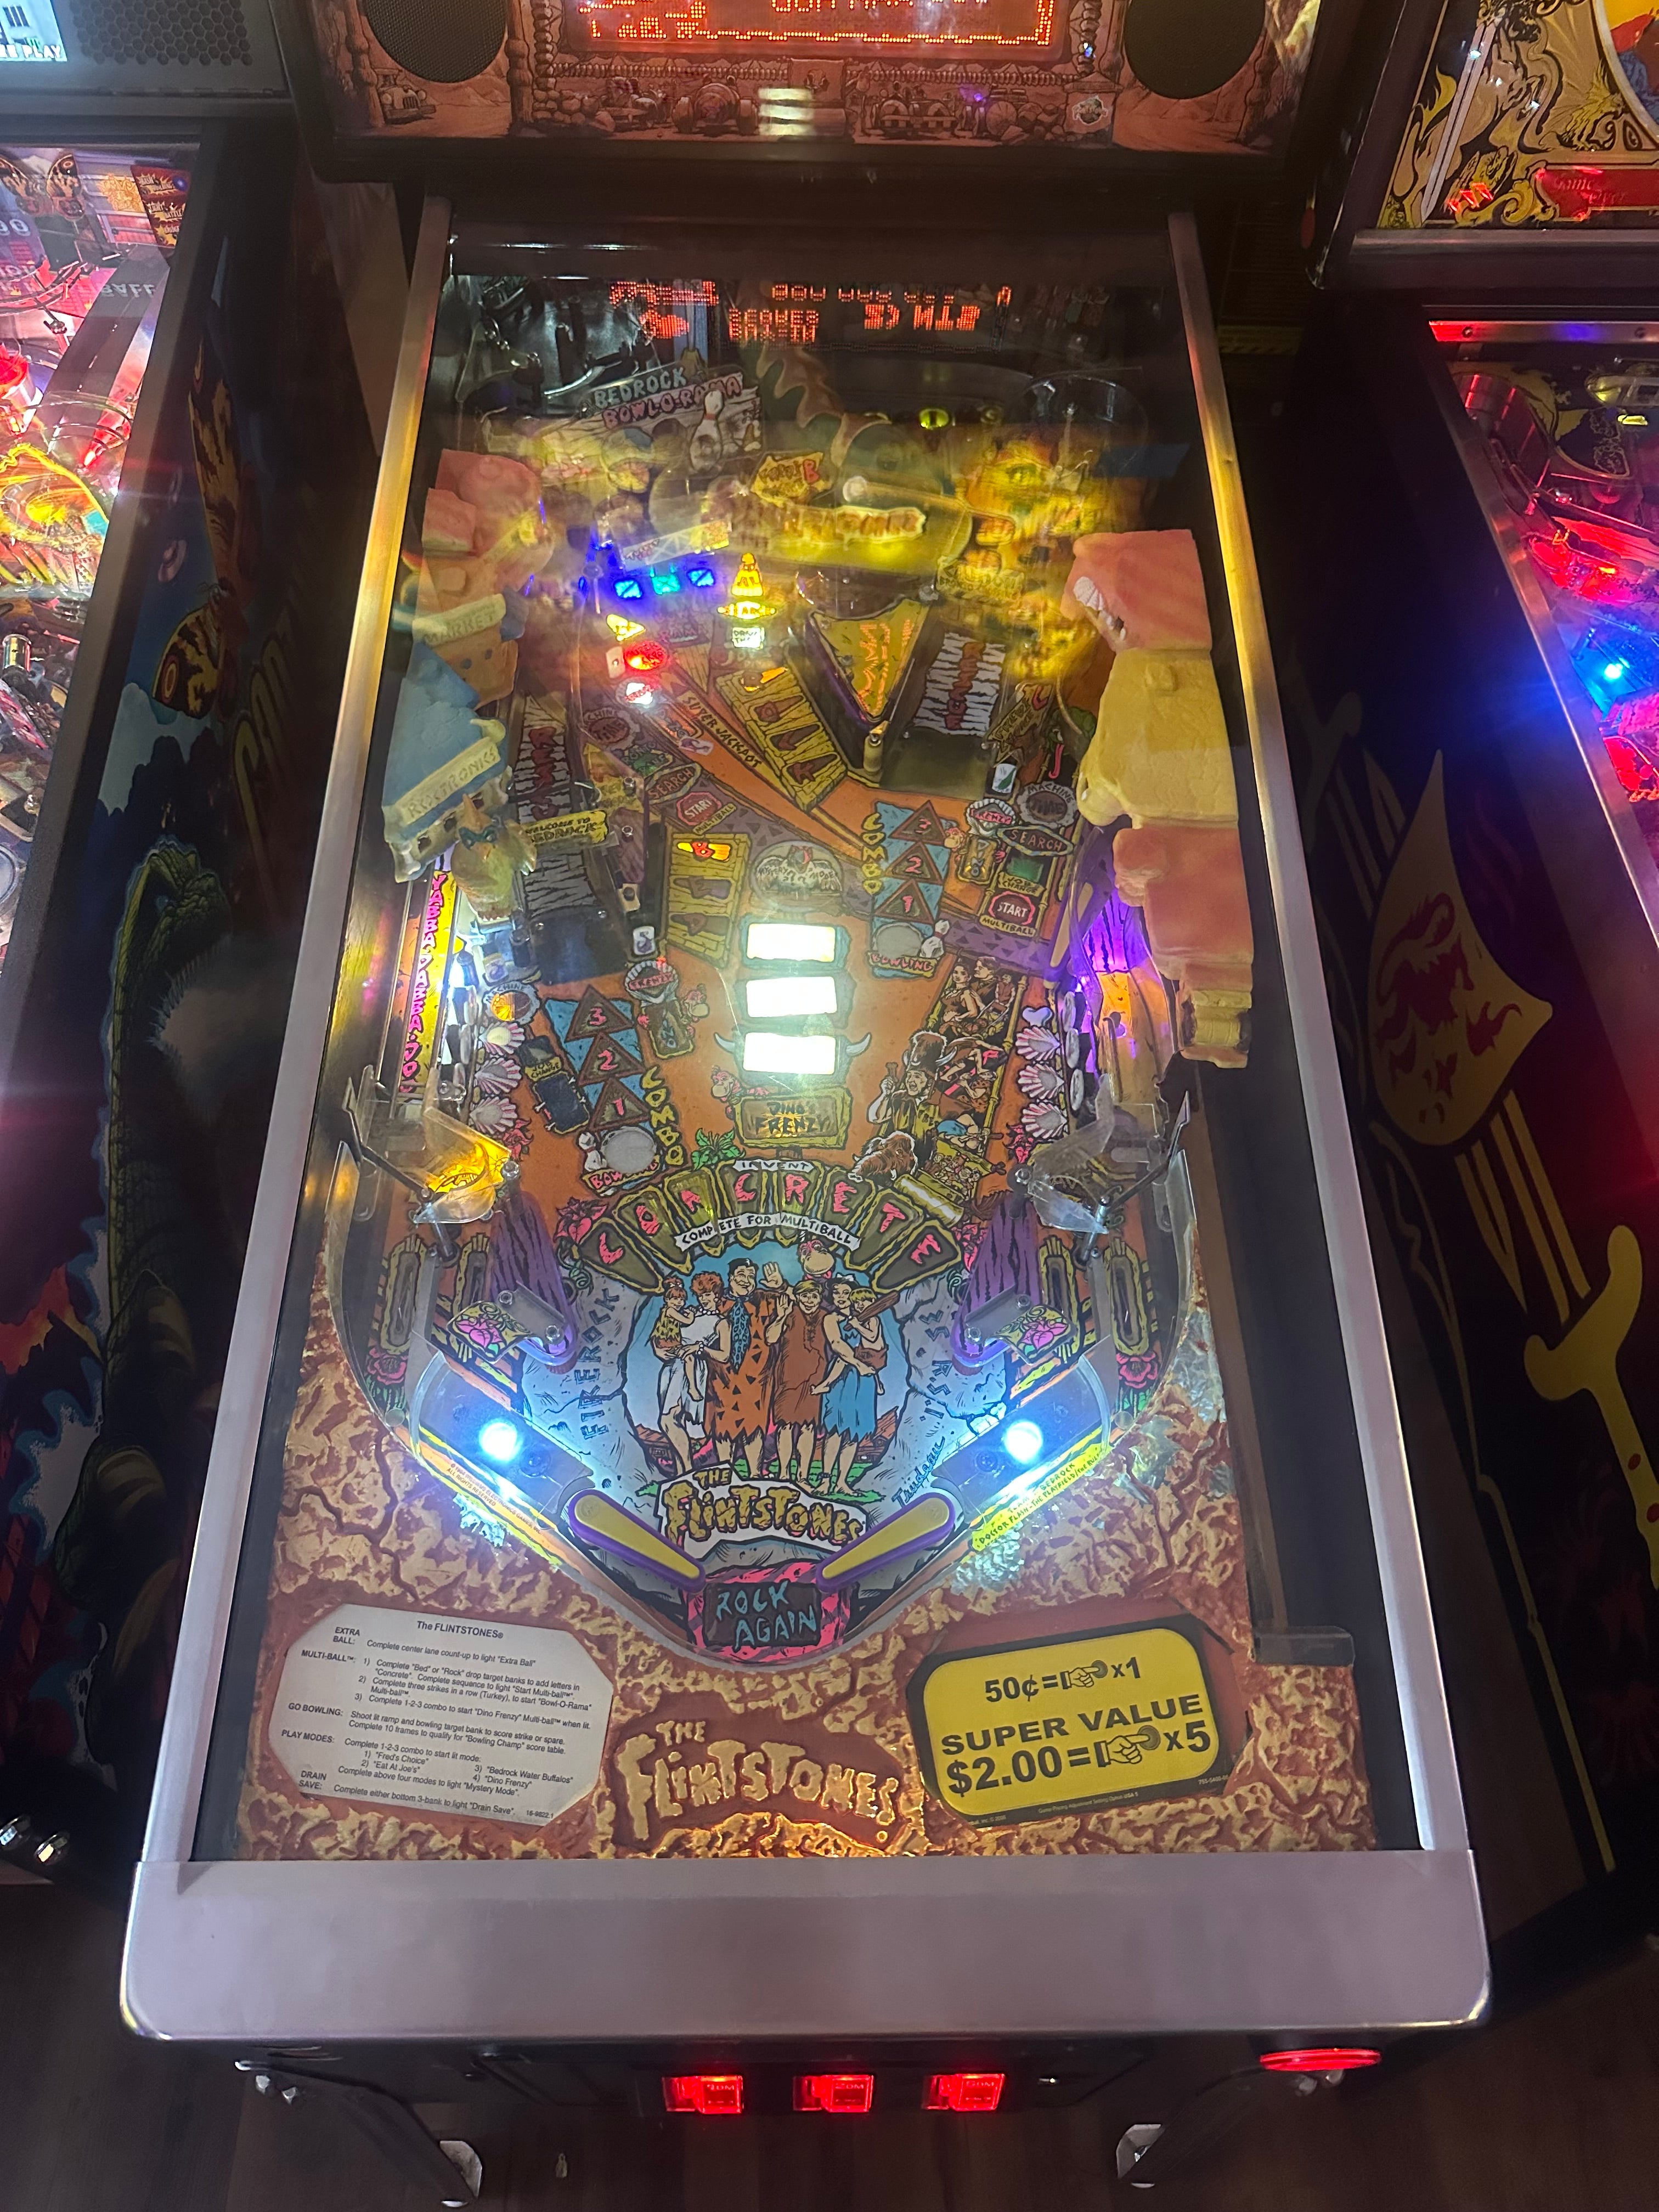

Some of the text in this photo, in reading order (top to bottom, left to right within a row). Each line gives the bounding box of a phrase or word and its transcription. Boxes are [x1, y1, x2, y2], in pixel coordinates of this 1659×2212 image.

[22, 44, 61, 59] PLAY
[594, 366, 686, 409] BEDROCK
[684, 695, 718, 729] SUPER
[715, 725, 762, 768] JACKPOT
[648, 768, 695, 799] SEARCH
[1028, 782, 1074, 804] MACHINE
[684, 799, 712, 818] START
[695, 805, 735, 833] MULTIBALL
[918, 817, 932, 834] 3
[1010, 829, 1063, 851] SEARCH
[862, 813, 887, 895] COMBO
[905, 856, 922, 874] 2
[1002, 882, 1037, 894] CHANGE
[902, 895, 913, 913] 1
[997, 901, 1028, 918] START
[982, 917, 1035, 935] MULTIBALL
[589, 1006, 606, 1026] 3
[597, 1049, 618, 1070] 2
[531, 1062, 561, 1079] CHANGE
[613, 1098, 625, 1116] 1
[641, 1067, 684, 1166] COMBO
[755, 1117, 830, 1135] FRENZY
[742, 1161, 809, 1170] INVENT
[682, 1214, 854, 1244] COMPETE FOR MULTIBALL
[446, 1468, 456, 1477] ALL
[456, 1474, 473, 1489] RIGHTS
[472, 1486, 496, 1506] RESERVED
[694, 1468, 732, 1490] THE
[515, 1513, 534, 1530] GAMES,
[978, 1521, 1009, 1544] DOCTOR
[715, 1580, 789, 1621] ROCK
[335, 1626, 360, 1637] EXTRA
[416, 1620, 433, 1630] The
[734, 1606, 817, 1648] AGAIN
[332, 1635, 356, 1645] BALL:
[366, 1639, 400, 1651] Complete
[401, 1645, 424, 1654] center
[424, 1646, 439, 1655] lane
[441, 1650, 471, 1661] count-up
[480, 1654, 496, 1663] light
[364, 1657, 370, 1667] 1)
[376, 1658, 410, 1670] Complete
[465, 1670, 482, 1680] drop
[482, 1673, 504, 1683] target
[504, 1675, 526, 1685] banks
[535, 1679, 550, 1688] add
[550, 1680, 572, 1691] letters
[573, 1683, 580, 1691] in
[1113, 1657, 1141, 1679] x1
[417, 1673, 450, 1686] Complete
[451, 1679, 486, 1689] sequence
[486, 1683, 494, 1691] to
[495, 1683, 511, 1692] light
[288, 1702, 343, 1717] GO BOWLING:
[350, 1711, 373, 1720] Shoot
[381, 1716, 400, 1725] ramp
[400, 1718, 415, 1726] and
[415, 1719, 443, 1731] bowling
[444, 1723, 465, 1733] target
[465, 1725, 484, 1736] bank
[493, 1730, 513, 1740] score
[514, 1733, 533, 1743] strike
[543, 1736, 566, 1746] spare.
[656, 1720, 707, 1746] THE
[941, 1694, 1203, 1755] SUPER VALUE
[281, 1729, 335, 1743] PLAY MODES:
[1165, 1720, 1211, 1753] x5
[344, 1737, 379, 1750] Complete
[381, 1742, 399, 1753] 1-2-3
[400, 1746, 425, 1756] combo
[433, 1750, 450, 1759] start
[364, 1750, 371, 1759] 1)
[301, 1770, 327, 1781] DRAIN
[473, 1764, 483, 1775] 3)
[520, 1770, 541, 1780] Water
[298, 1780, 323, 1790] SAVE:
[334, 1784, 368, 1796] Complete
[369, 1789, 391, 1798] either
[391, 1791, 416, 1802] bottom
[417, 1795, 442, 1805] 3-bank
[444, 1798, 451, 1808] to
[452, 1799, 468, 1810] light
